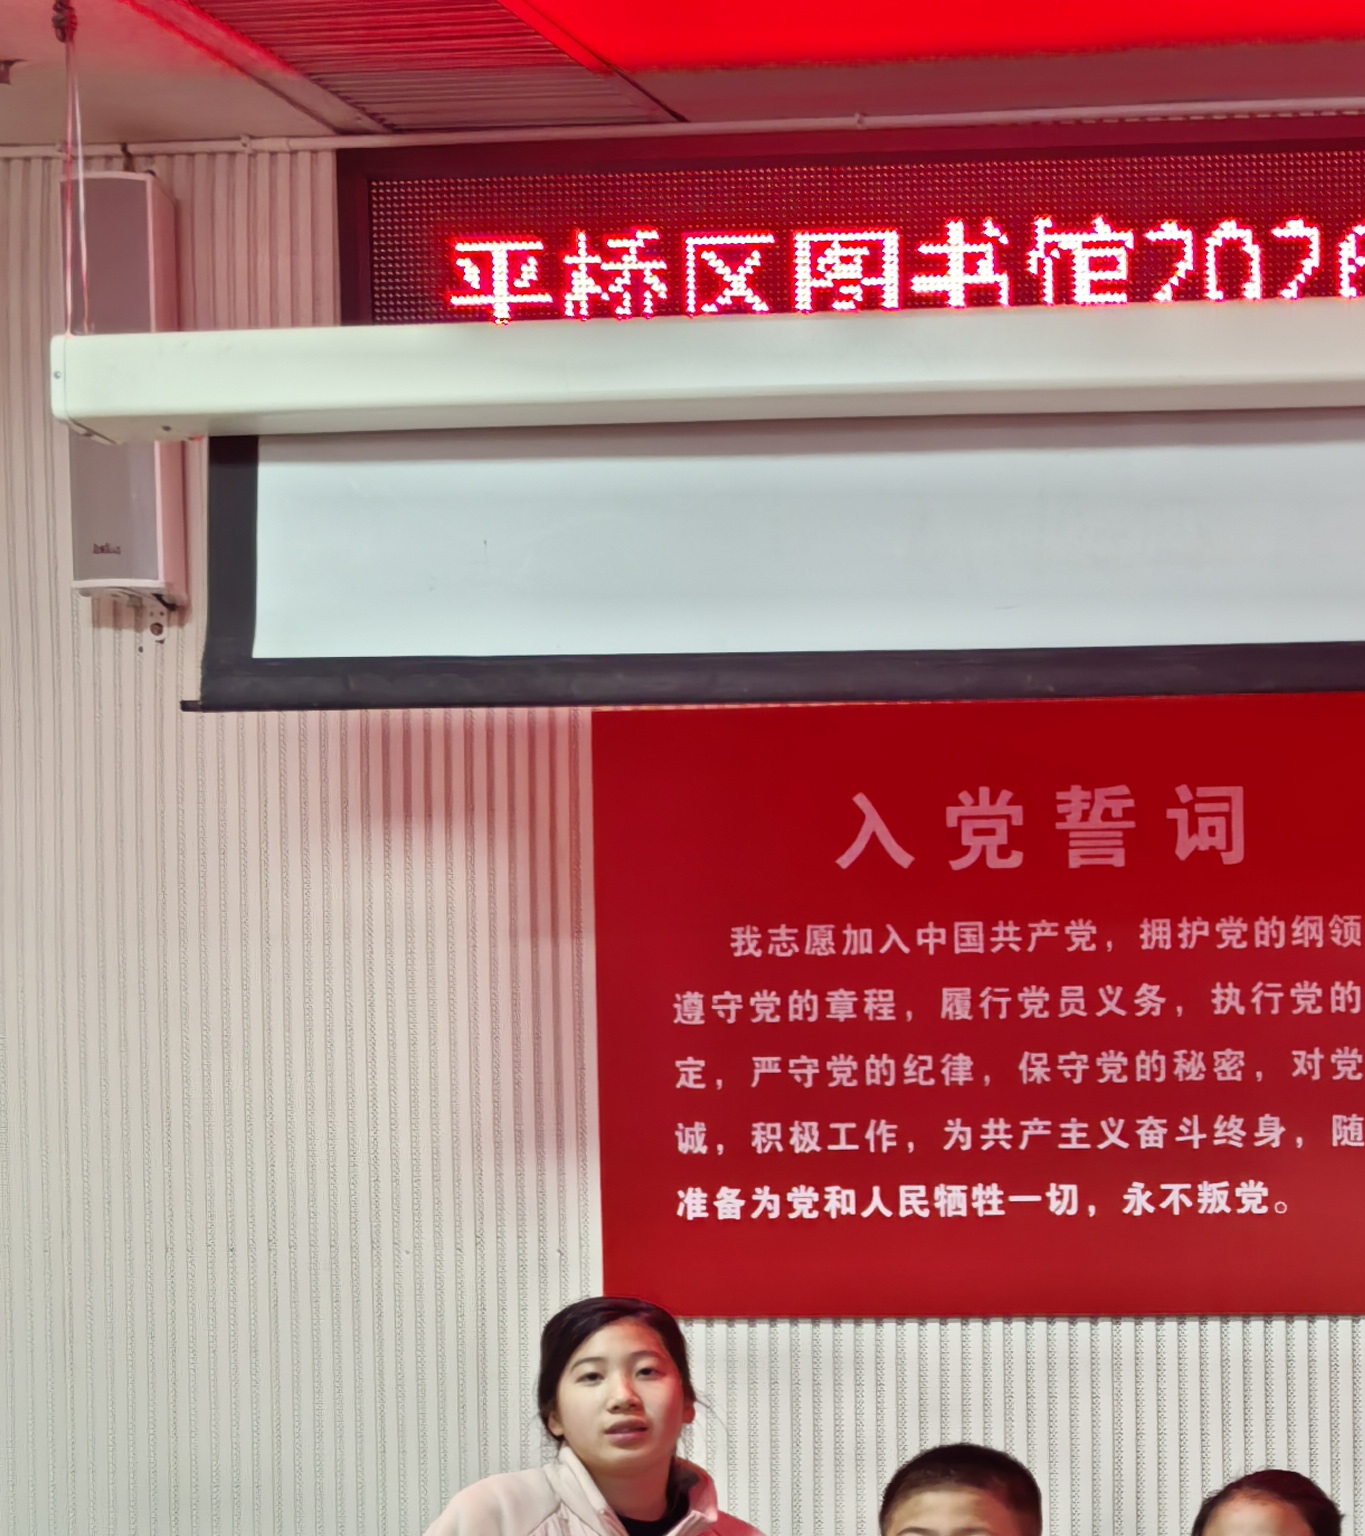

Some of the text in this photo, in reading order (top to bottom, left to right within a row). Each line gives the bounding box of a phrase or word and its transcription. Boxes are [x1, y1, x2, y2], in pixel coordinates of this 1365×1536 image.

[834, 783, 1245, 872] 入党誓词
[675, 1178, 1289, 1222] 准备为党和人民牺牲一切，永不叛党。
